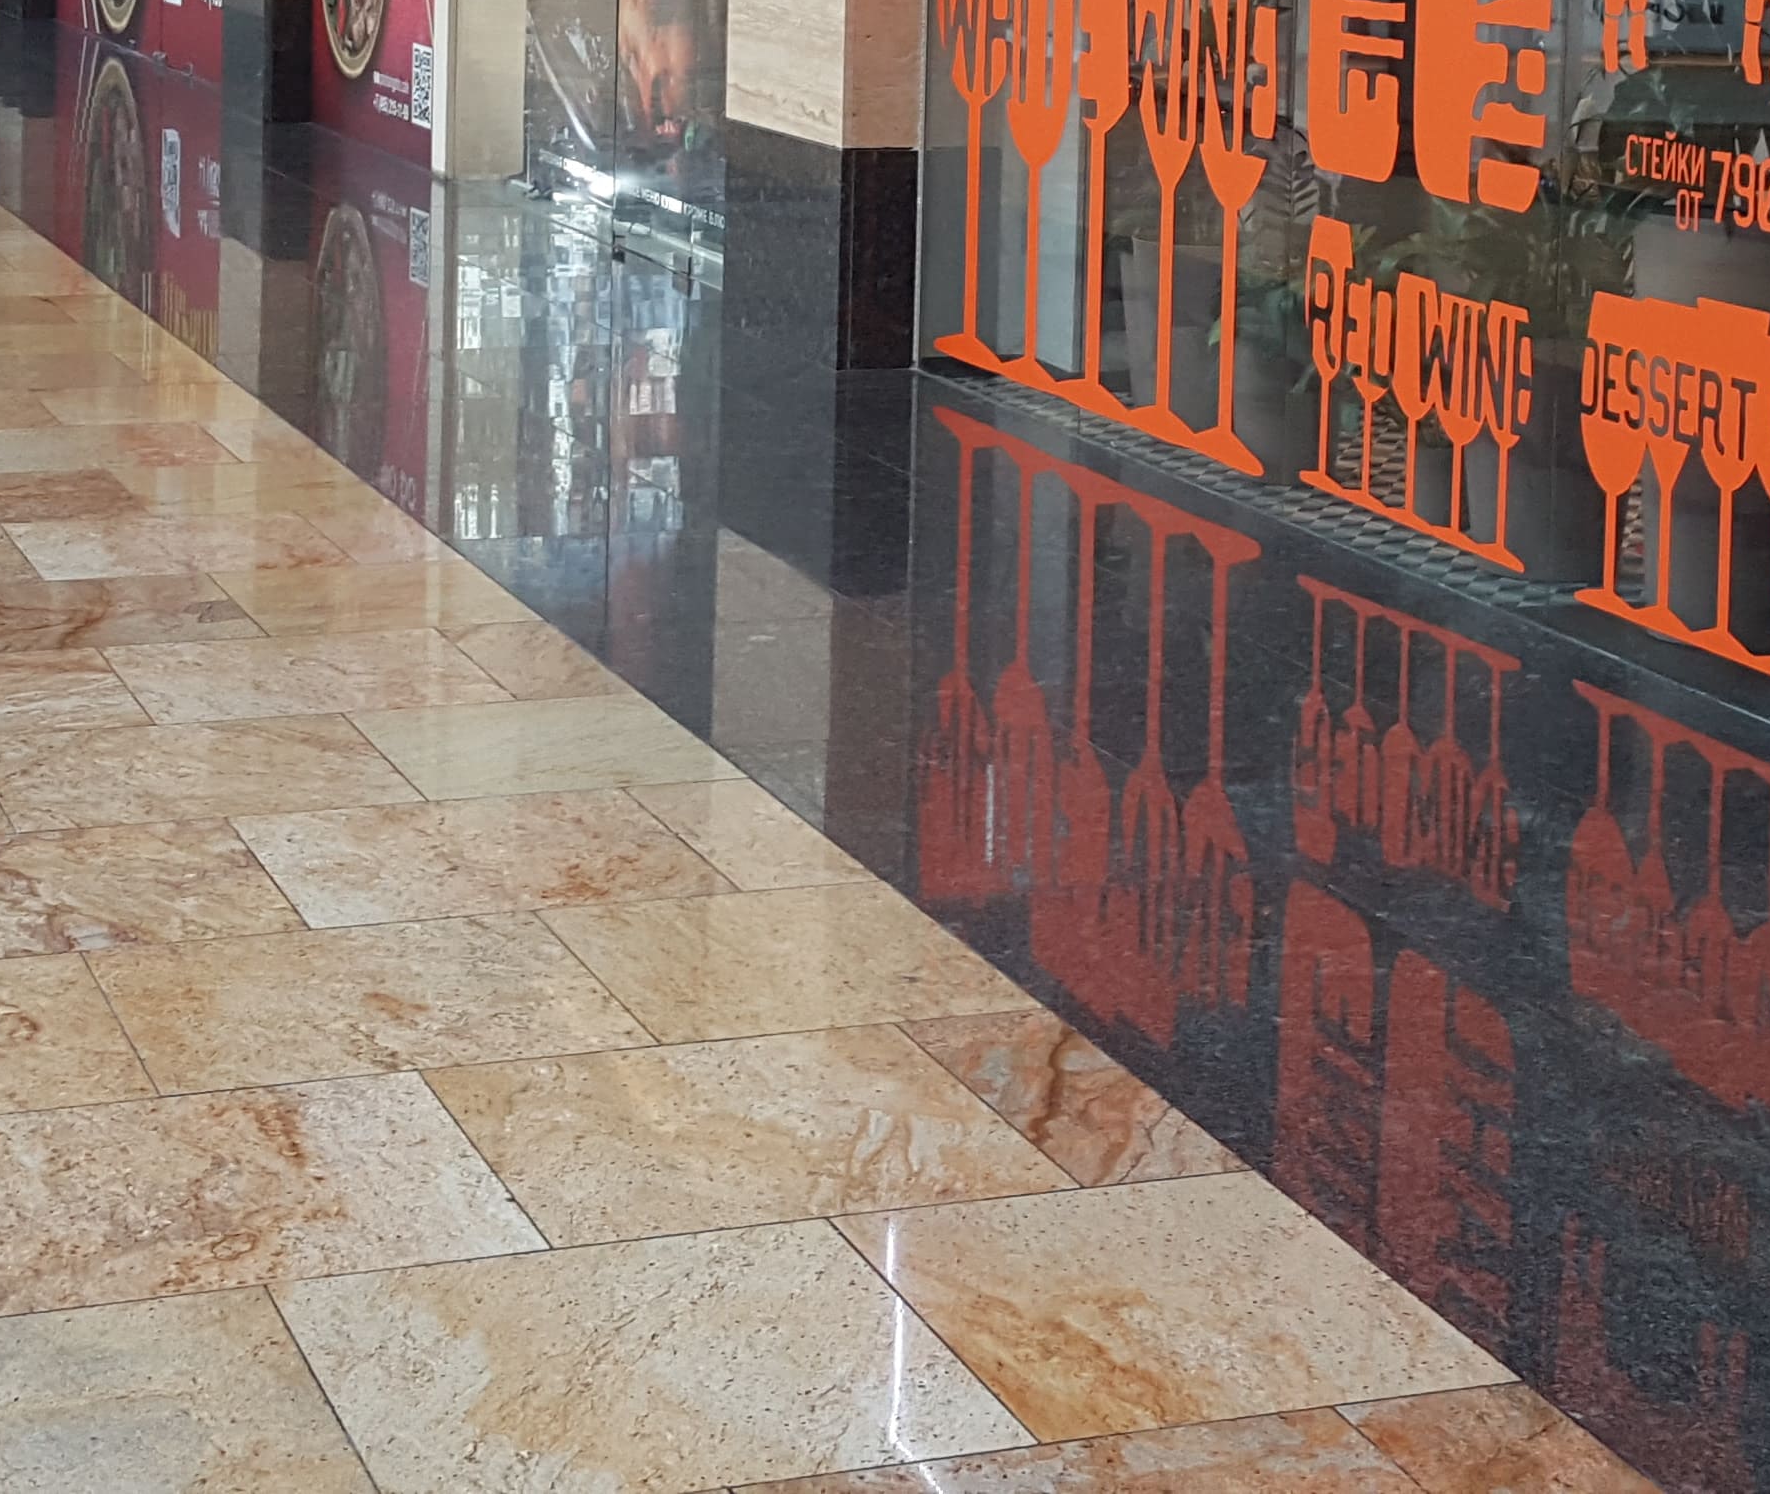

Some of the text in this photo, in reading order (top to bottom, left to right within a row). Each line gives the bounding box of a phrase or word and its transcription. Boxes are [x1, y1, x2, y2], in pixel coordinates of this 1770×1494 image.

[1625, 132, 1705, 188] СТЕЙКИ
[1676, 189, 1703, 232] ОТ
[1581, 335, 1757, 466] DESSERT
